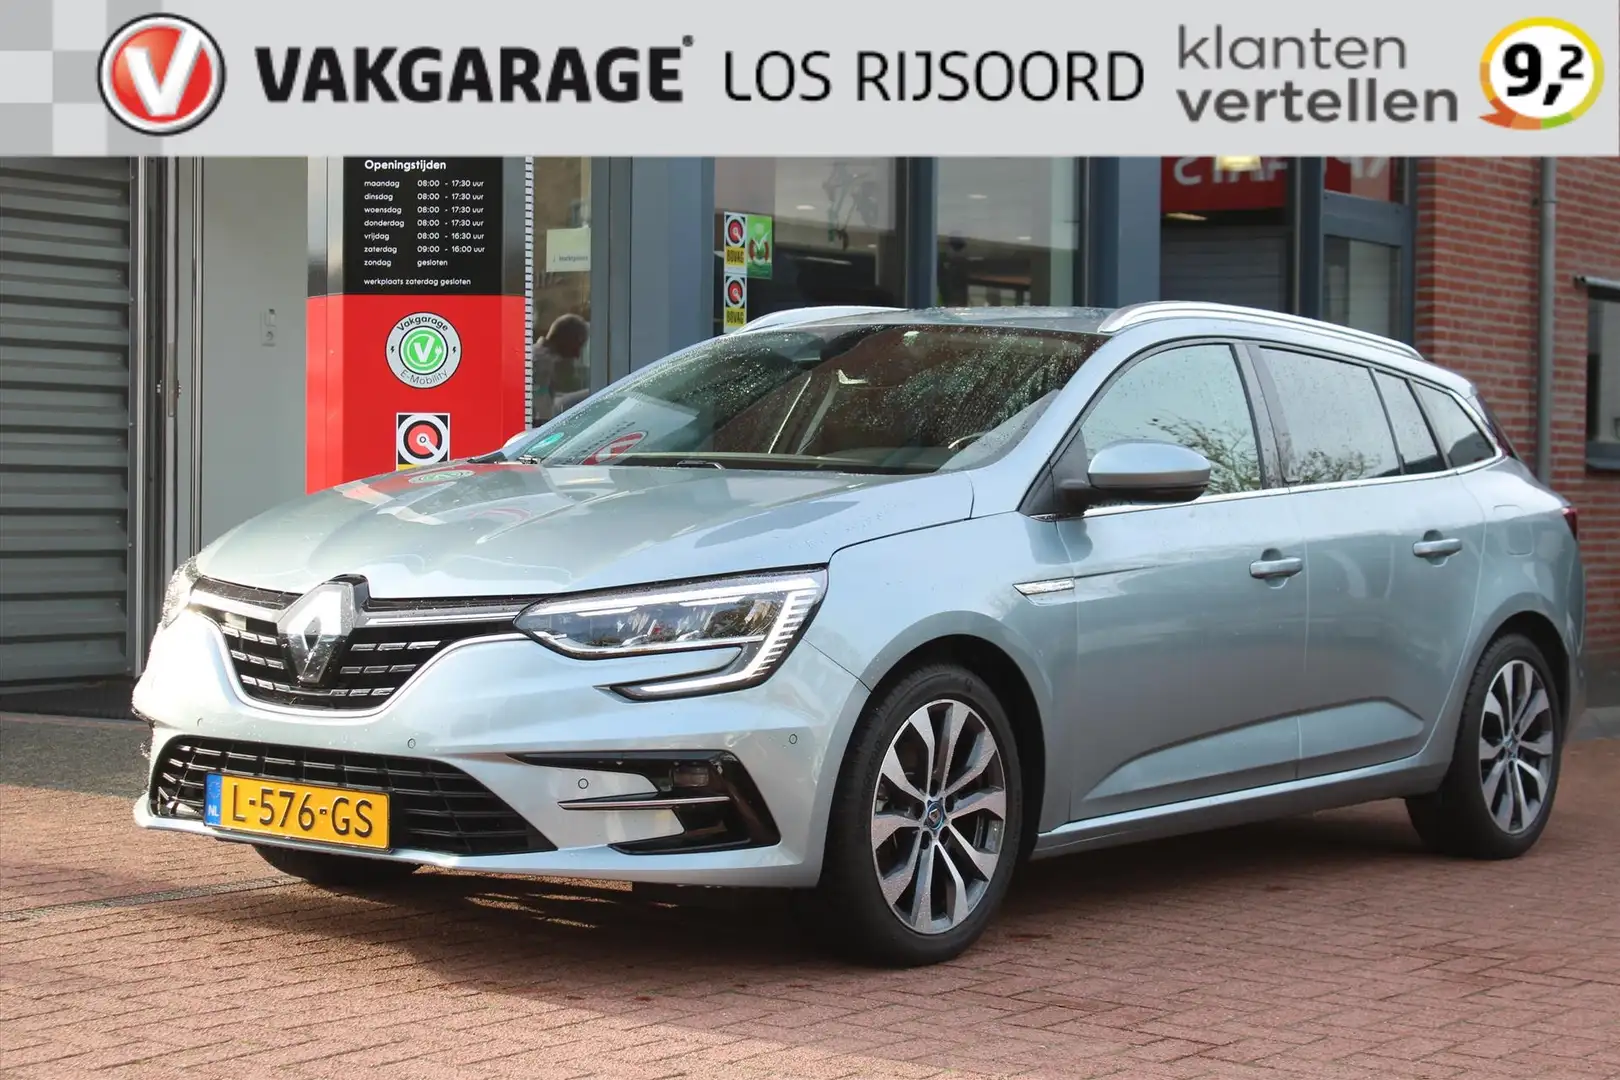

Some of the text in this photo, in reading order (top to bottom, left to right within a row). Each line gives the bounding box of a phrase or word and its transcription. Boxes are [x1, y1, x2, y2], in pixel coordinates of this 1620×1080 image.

[364, 159, 447, 172] Openingstijden
[363, 180, 400, 188] maandag
[363, 193, 394, 201] dinsdag
[363, 206, 402, 214] woensdag
[363, 219, 405, 227] donderdag
[363, 233, 390, 241] vrijdag
[363, 246, 398, 254] zaterdag
[363, 259, 448, 268] zondag gesloten
[363, 278, 472, 287] werkplaats zaterdag gesloten
[726, 310, 744, 325] BOVAG
[396, 316, 449, 331] Vakgarage
[400, 369, 448, 385] E-Mobility
[207, 805, 220, 817] NL
[232, 784, 373, 838] L-576-GS
